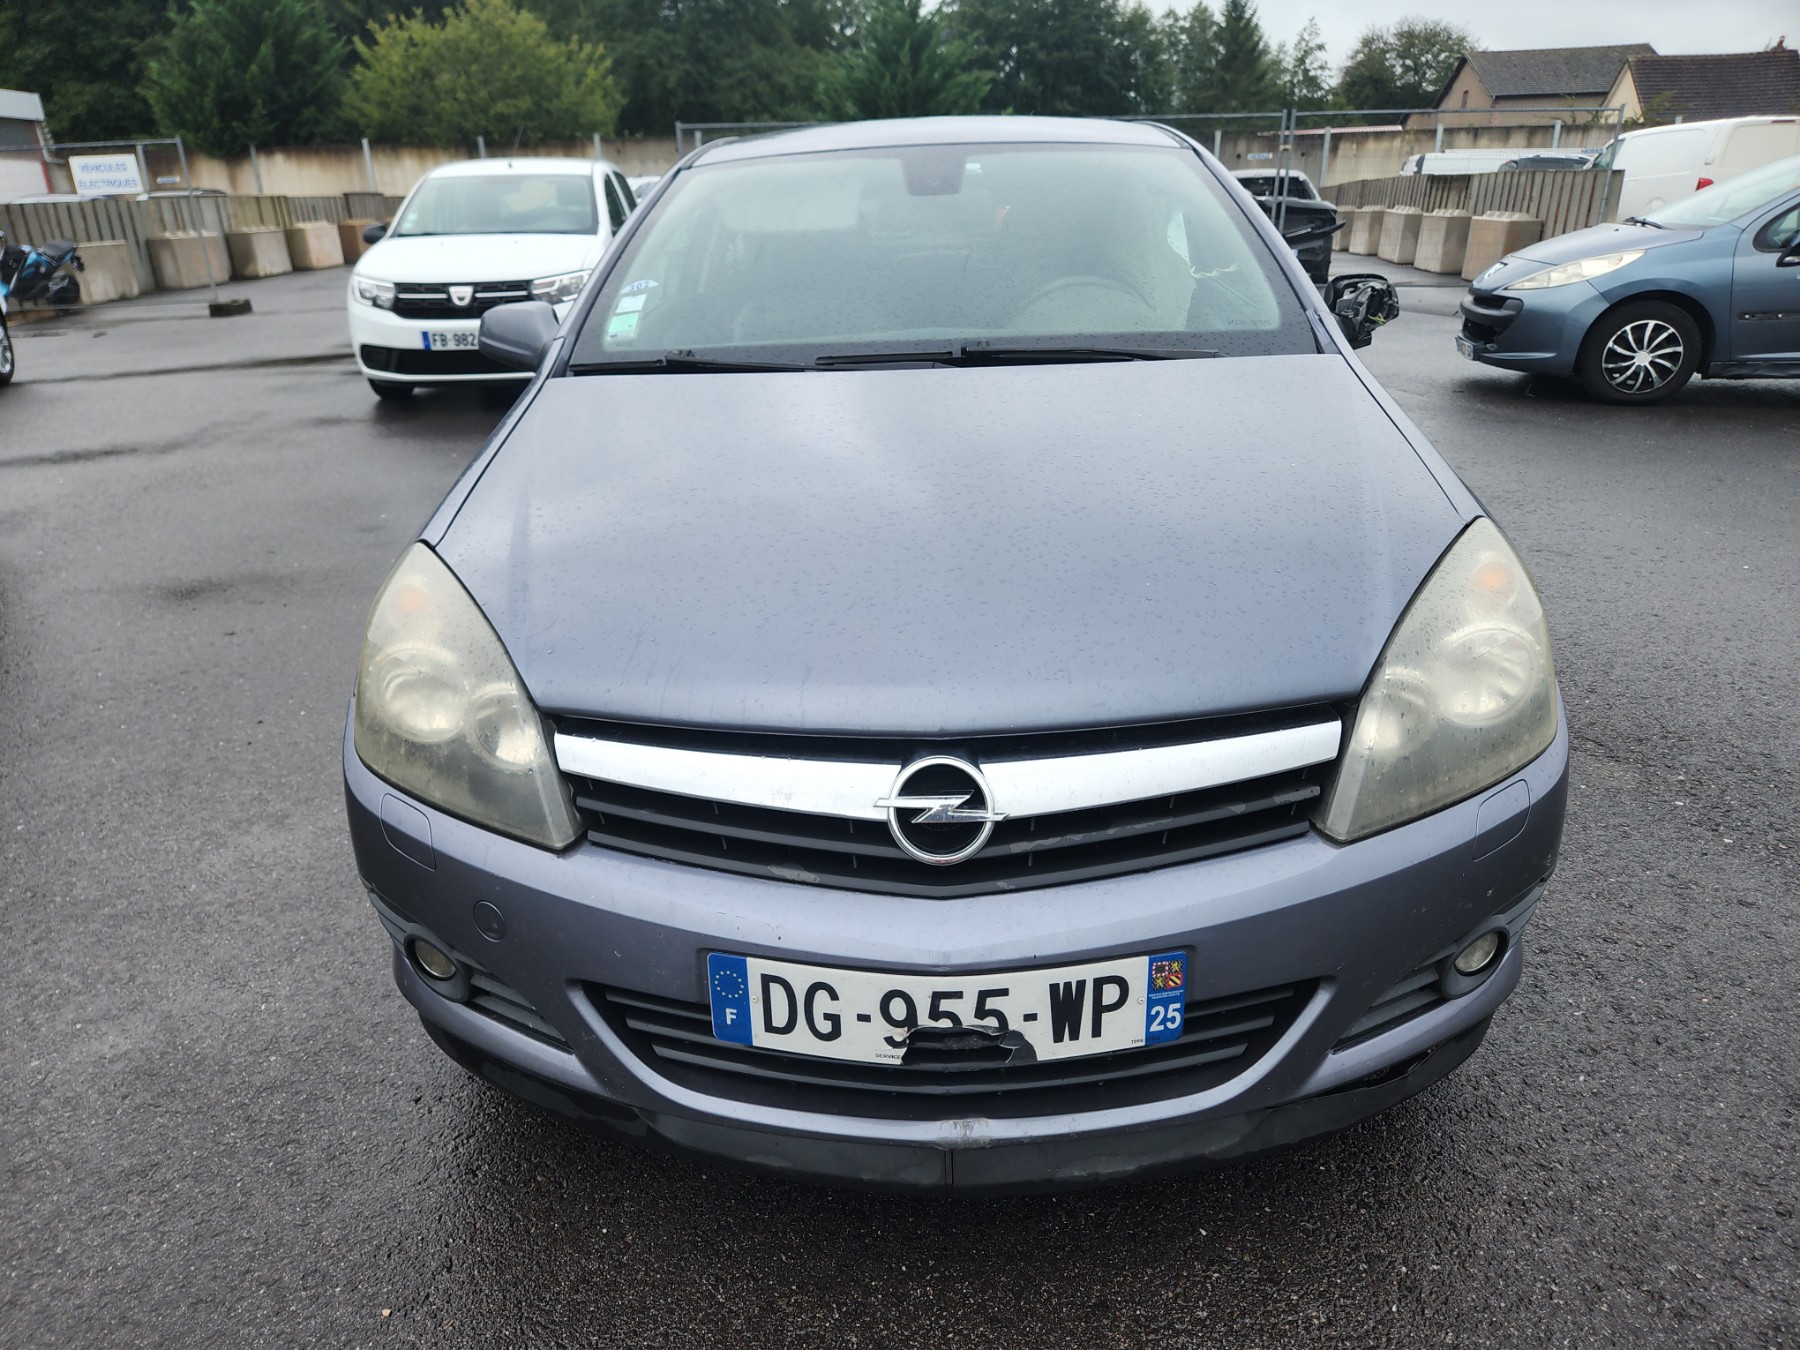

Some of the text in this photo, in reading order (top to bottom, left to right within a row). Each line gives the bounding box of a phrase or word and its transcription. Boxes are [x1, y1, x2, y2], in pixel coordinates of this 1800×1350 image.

[725, 1008, 737, 1025] F
[760, 973, 1130, 1049] DG-955-WP
[1150, 1003, 1181, 1032] 25
